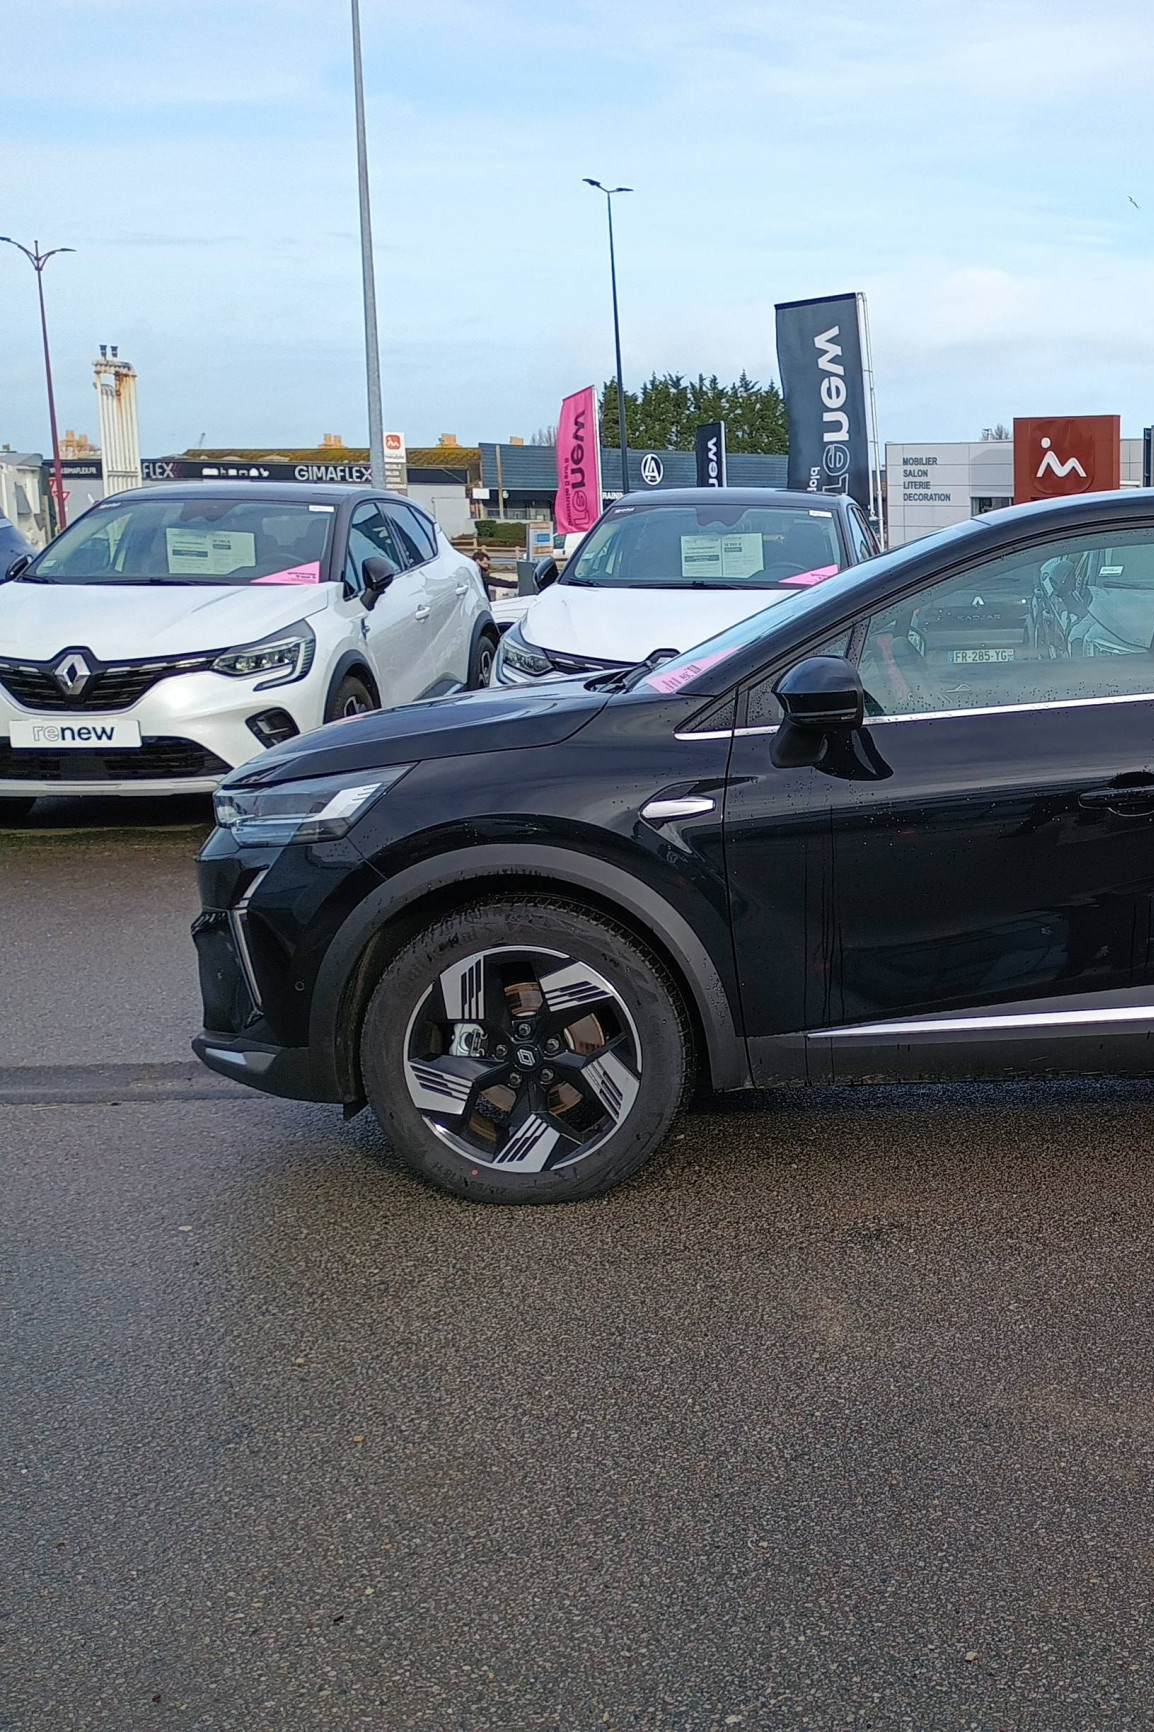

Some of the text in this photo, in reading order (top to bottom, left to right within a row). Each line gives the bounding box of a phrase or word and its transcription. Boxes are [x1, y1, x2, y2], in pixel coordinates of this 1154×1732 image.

[902, 457, 938, 466] MOBILIER
[294, 465, 372, 482] GIMAFLEX
[902, 469, 929, 478] SALON
[903, 481, 931, 490] LITERIE
[903, 492, 951, 502] DECORATION
[955, 650, 1008, 662] FR-285-YG
[33, 725, 115, 742] renew
